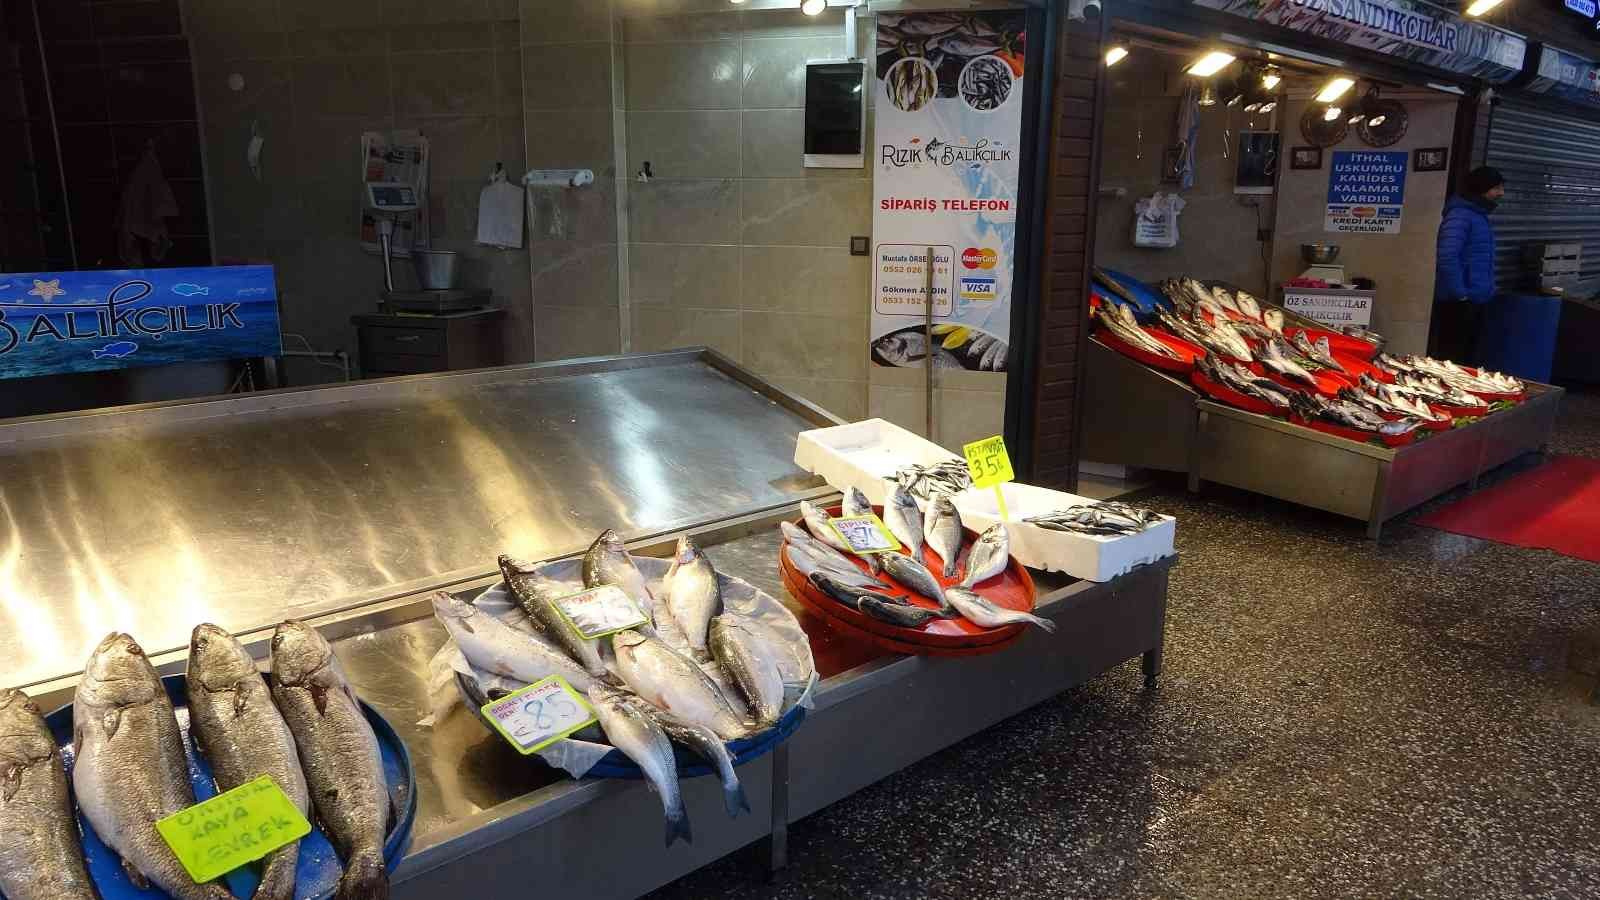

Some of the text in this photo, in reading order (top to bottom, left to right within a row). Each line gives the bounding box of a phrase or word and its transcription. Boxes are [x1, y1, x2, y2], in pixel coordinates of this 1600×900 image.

[882, 145, 922, 167] RIZIK
[1350, 152, 1388, 162] İTHAL
[1335, 164, 1402, 172] USKUMRU
[1339, 174, 1396, 183] KARİDES
[1334, 185, 1400, 193] KALAMAR
[881, 197, 1009, 213] SİPARİŞ TELEFON
[1333, 217, 1361, 225] KREDİ
[967, 284, 991, 293] VISA
